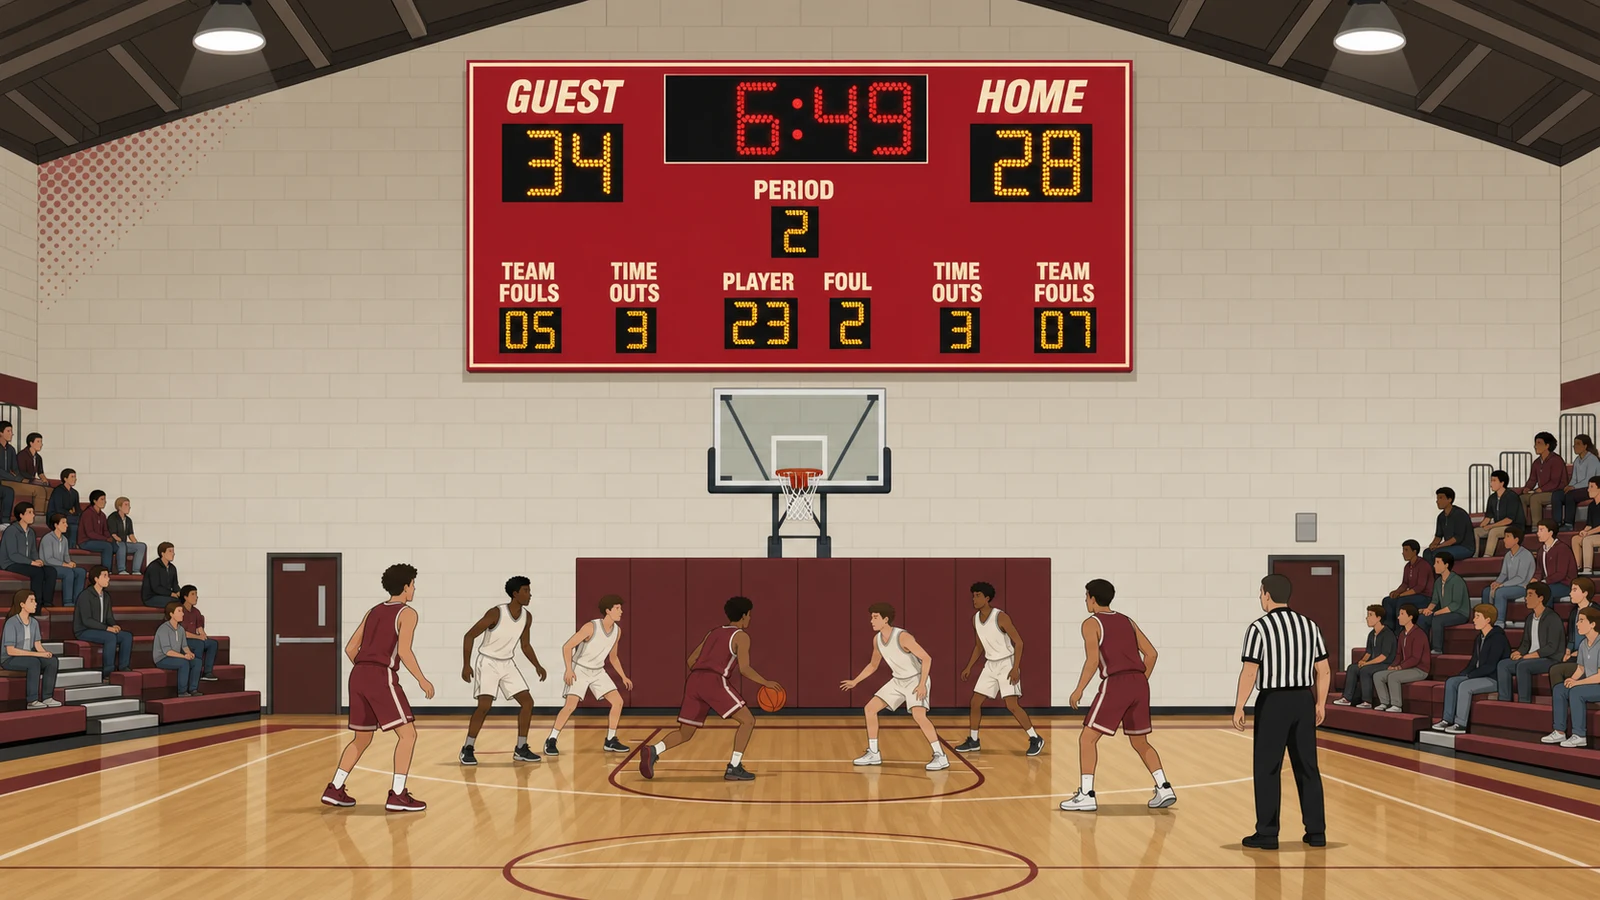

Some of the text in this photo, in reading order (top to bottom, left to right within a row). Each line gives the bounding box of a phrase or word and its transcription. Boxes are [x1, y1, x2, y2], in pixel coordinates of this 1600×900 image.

[507, 79, 624, 113] GUEST
[977, 79, 1088, 113] HOME
[737, 82, 911, 155] 6:49
[527, 130, 611, 196] 34
[994, 130, 1080, 196] 28
[755, 180, 833, 199] PERIOD
[784, 210, 808, 252] 2
[502, 262, 554, 280] TEAM
[611, 262, 657, 280] TIME
[724, 273, 794, 290] PLAYER
[825, 272, 872, 290] FOUL
[934, 262, 979, 280] TIME
[1037, 262, 1089, 280] TEAM
[500, 284, 559, 302] FOULS
[610, 284, 659, 302] OUTS
[933, 284, 982, 302] OUTS
[1035, 284, 1094, 302] FOULS
[506, 311, 555, 349] 05
[627, 311, 647, 349] 3
[733, 302, 789, 344] 23
[840, 302, 864, 344] 2
[951, 311, 971, 349] 3
[1041, 311, 1090, 349] 07
